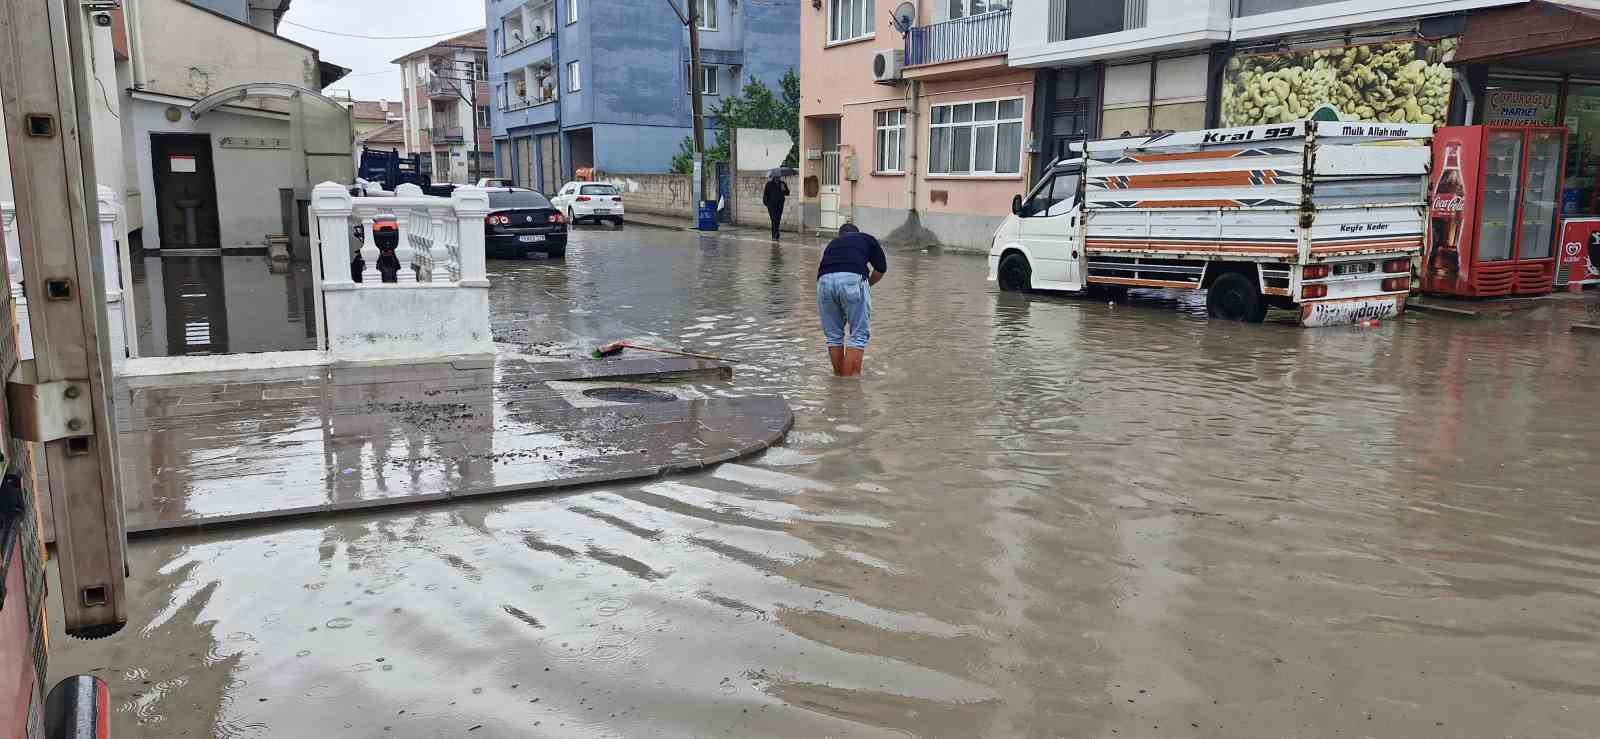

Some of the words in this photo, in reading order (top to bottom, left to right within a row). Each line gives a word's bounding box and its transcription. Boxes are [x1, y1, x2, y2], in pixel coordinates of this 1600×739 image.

[1503, 107, 1536, 117] MARKET
[1203, 130, 1254, 143] Kral
[1264, 127, 1296, 139] 99
[1340, 223, 1363, 233] Keyfe
[1367, 223, 1389, 231] Keder
